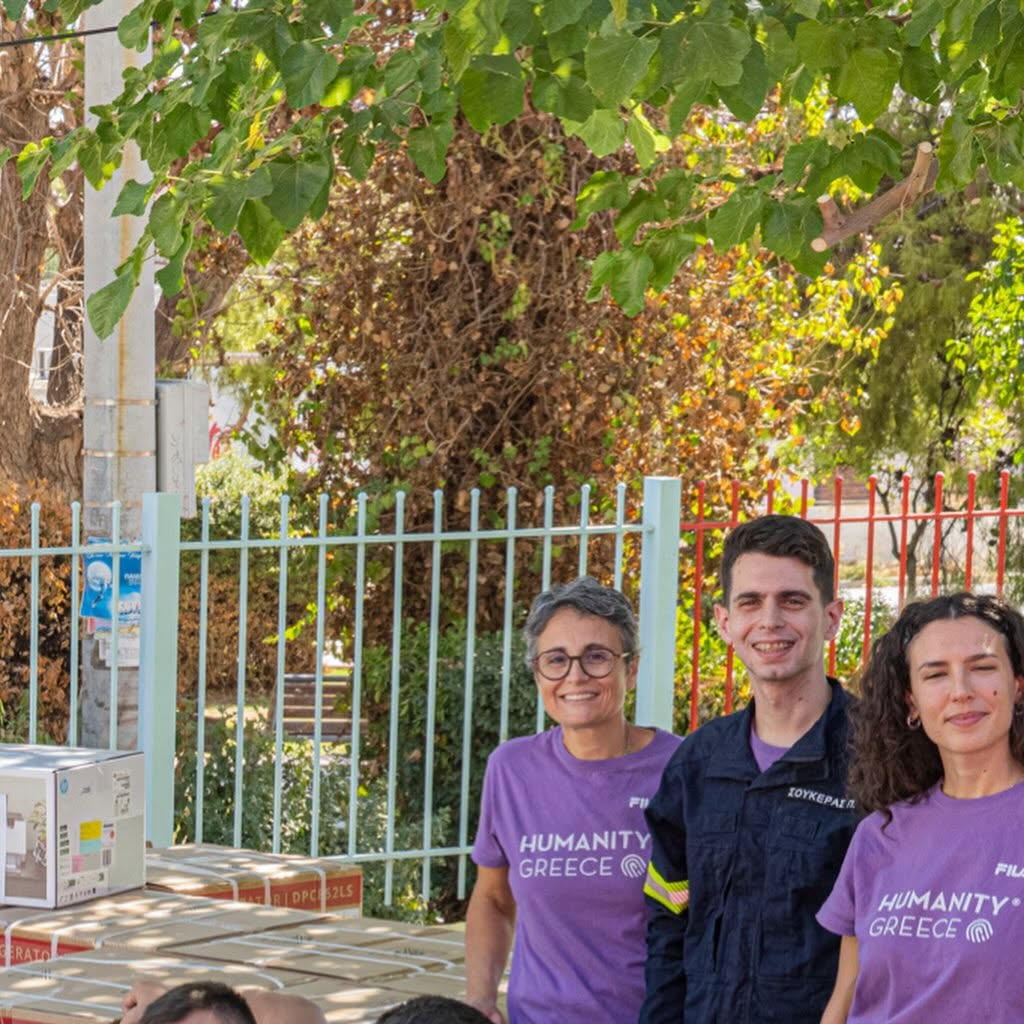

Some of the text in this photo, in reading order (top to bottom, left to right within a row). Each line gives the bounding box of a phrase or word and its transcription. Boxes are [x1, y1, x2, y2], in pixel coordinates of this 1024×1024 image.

[629, 797, 650, 809] FIL
[519, 830, 651, 853] HUMANITY
[519, 856, 614, 878] GREECE
[878, 889, 1009, 916] HUMANITY
[869, 915, 962, 939] GREECE
